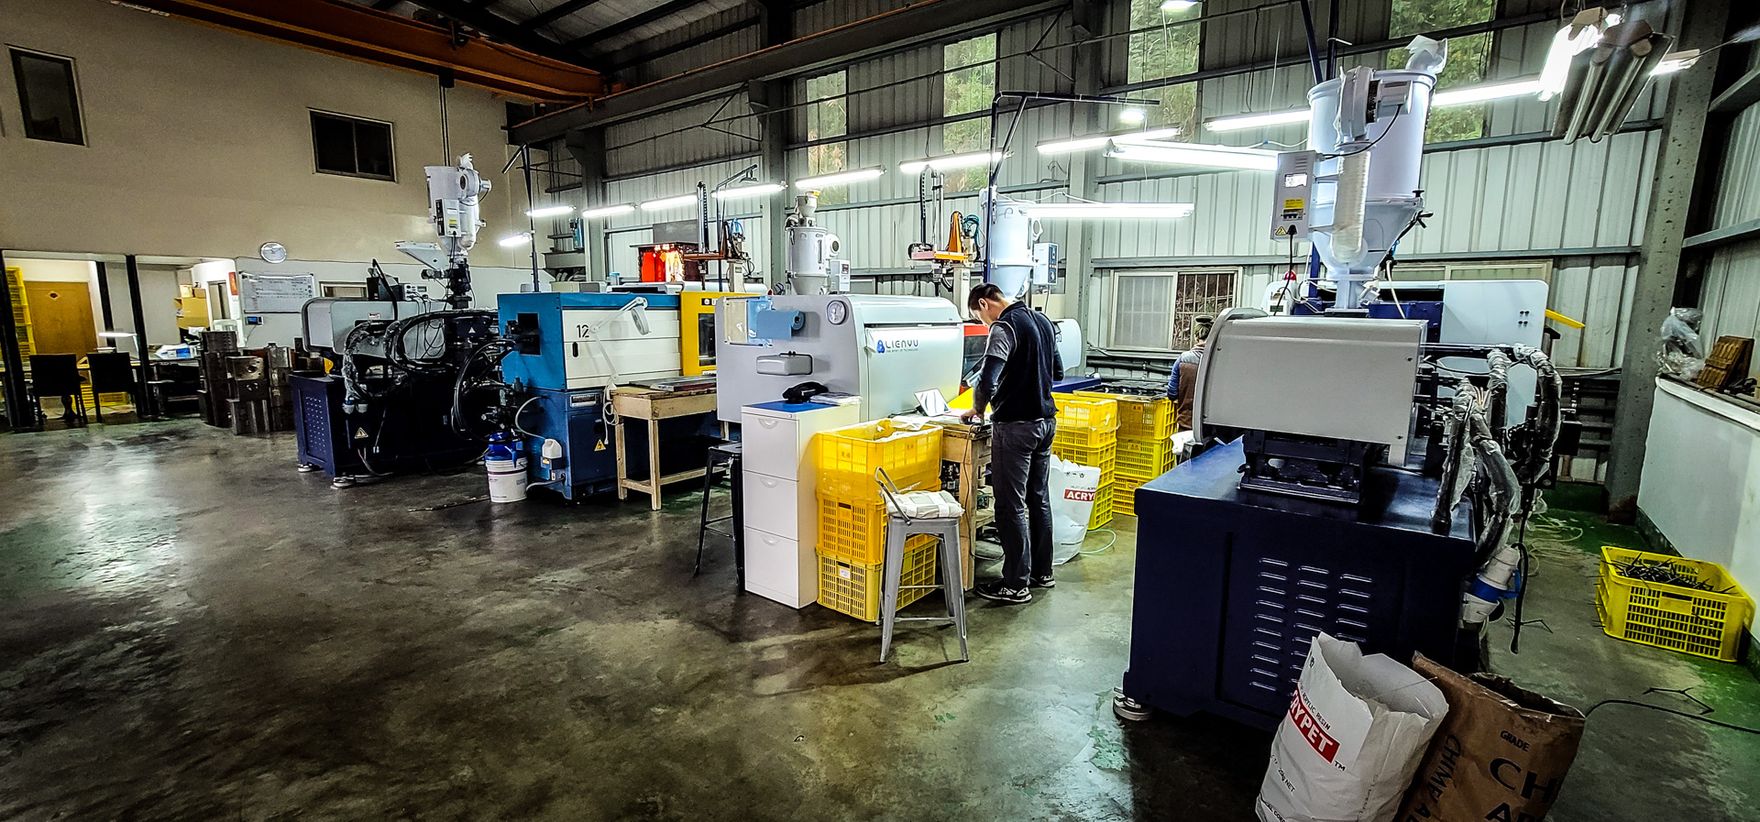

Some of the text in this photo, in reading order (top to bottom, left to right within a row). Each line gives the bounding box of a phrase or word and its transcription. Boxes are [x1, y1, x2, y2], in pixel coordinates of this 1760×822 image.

[576, 324, 590, 338] 12
[1067, 491, 1095, 501] ACRY
[1500, 730, 1530, 753] GRADE
[1334, 760, 1346, 772] TM
